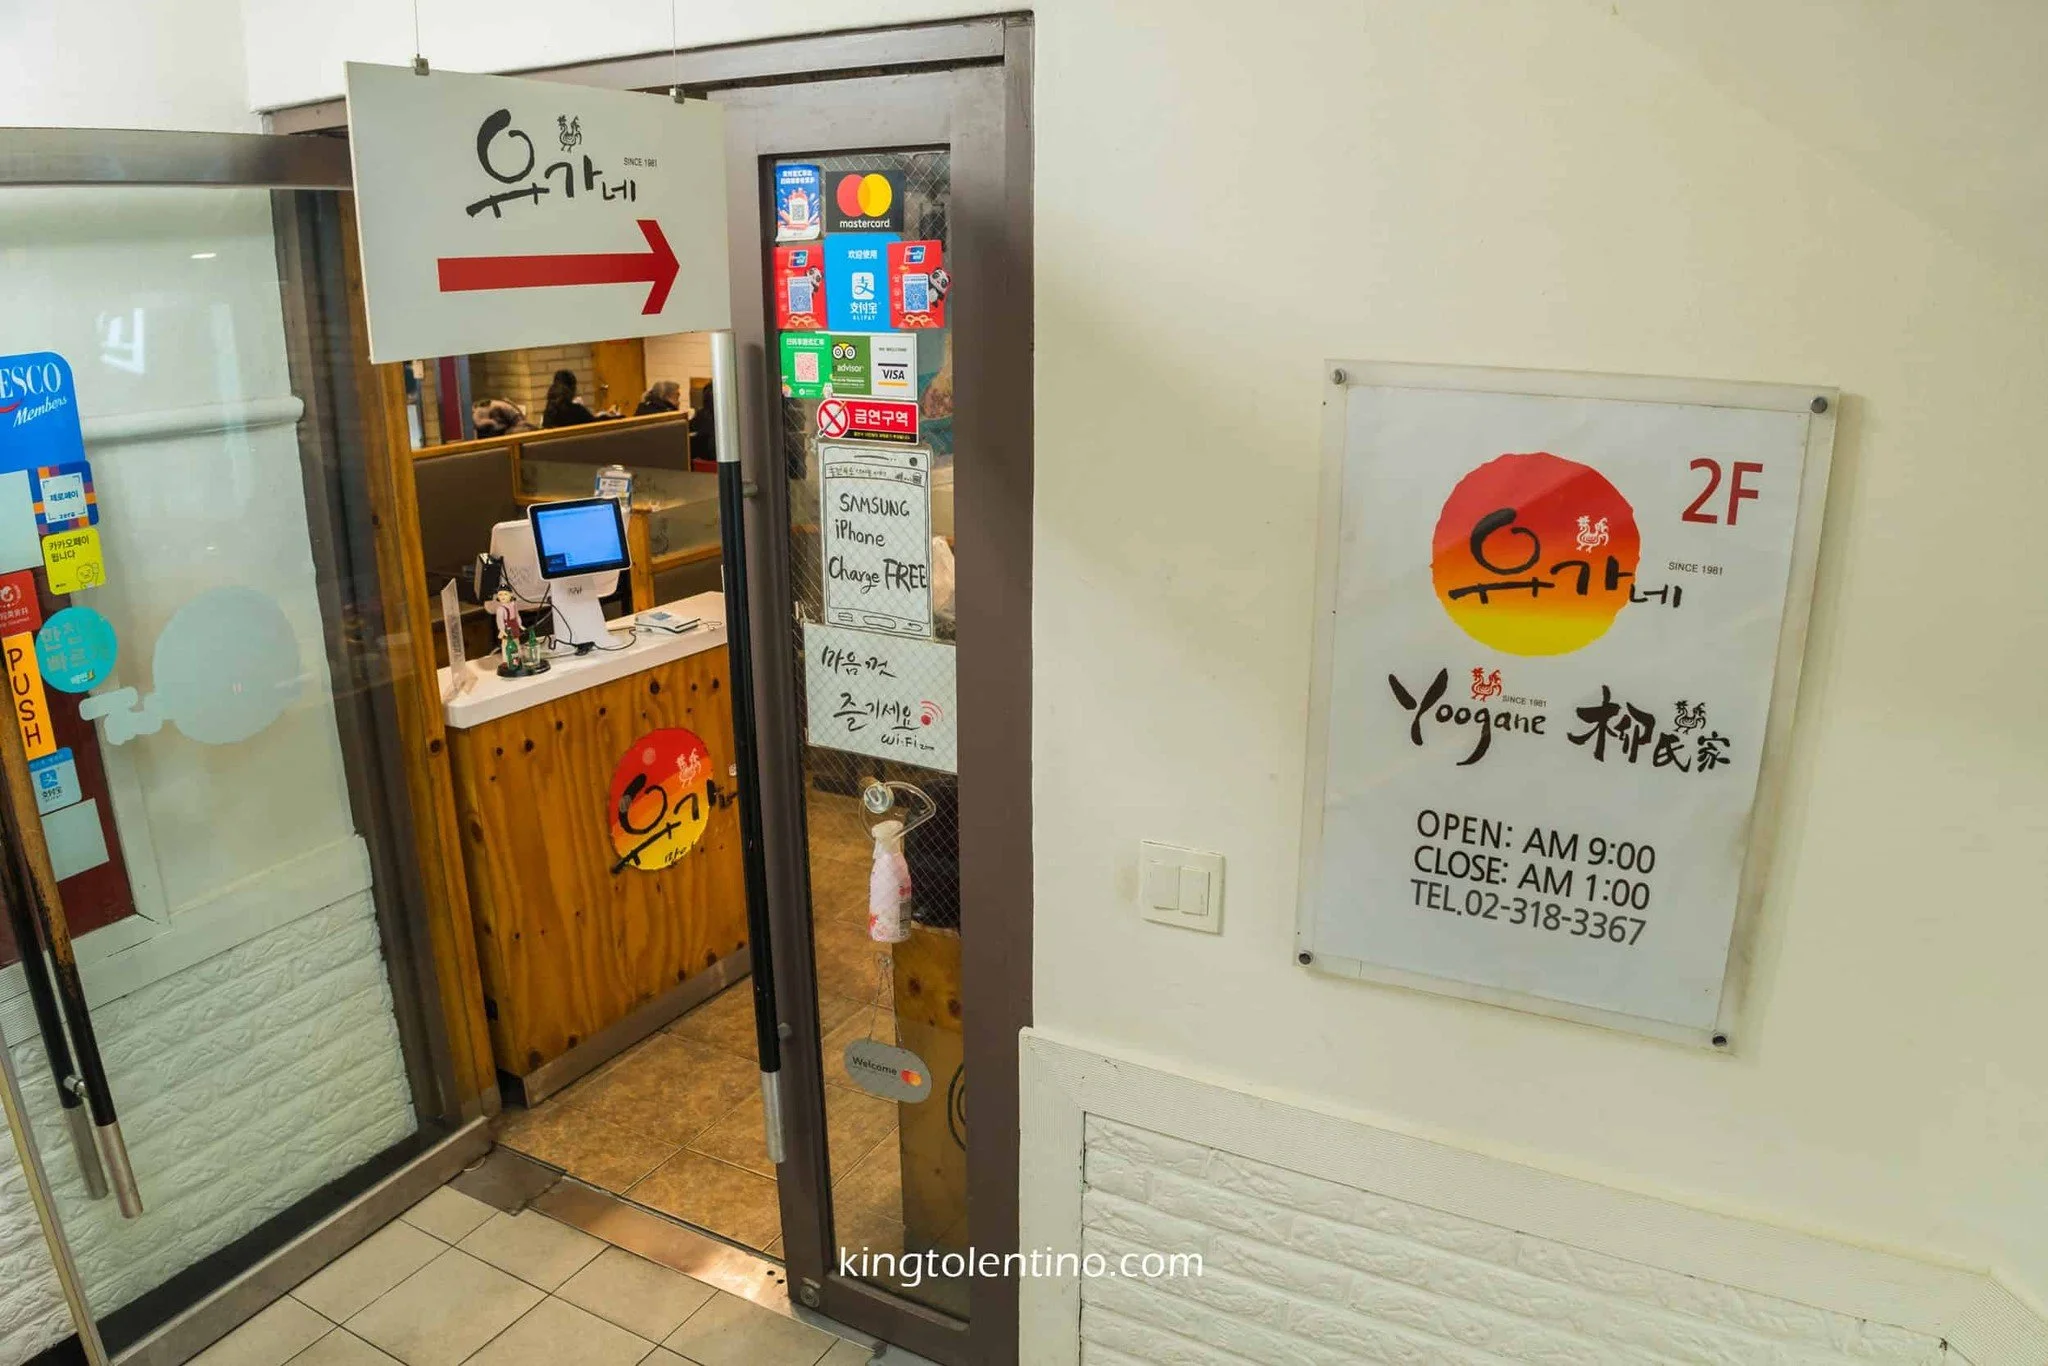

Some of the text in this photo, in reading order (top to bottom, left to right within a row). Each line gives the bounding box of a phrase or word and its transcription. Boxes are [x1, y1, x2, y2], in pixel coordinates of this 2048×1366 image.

[465, 108, 637, 218] 유가네
[623, 156, 658, 168] SINCE 1981
[839, 218, 891, 229] mastercard
[850, 302, 878, 315] 支付宝
[882, 369, 905, 380] VISA
[12, 395, 67, 428] Members
[855, 408, 909, 427] 금연구역
[839, 492, 910, 517] SAMSUNG
[1681, 457, 1764, 526] 2F
[48, 535, 90, 551] 카카오페이
[835, 518, 886, 547] iPhone
[1447, 507, 1683, 608] 유가네
[1668, 561, 1724, 576] SINCE 1981
[828, 555, 928, 595] Charge FREE
[7, 648, 42, 748] PUSH
[832, 692, 921, 732] 즐기세요
[1501, 694, 1547, 707] SINCE 1981
[1388, 667, 1547, 766] Yoogane
[1417, 809, 1656, 874] OPEN: AM 9:00
[1414, 845, 1650, 911] CLOSE: AM 1:00
[1410, 878, 1647, 946] TEL.02-318-3367
[852, 1056, 898, 1076] Welcome
